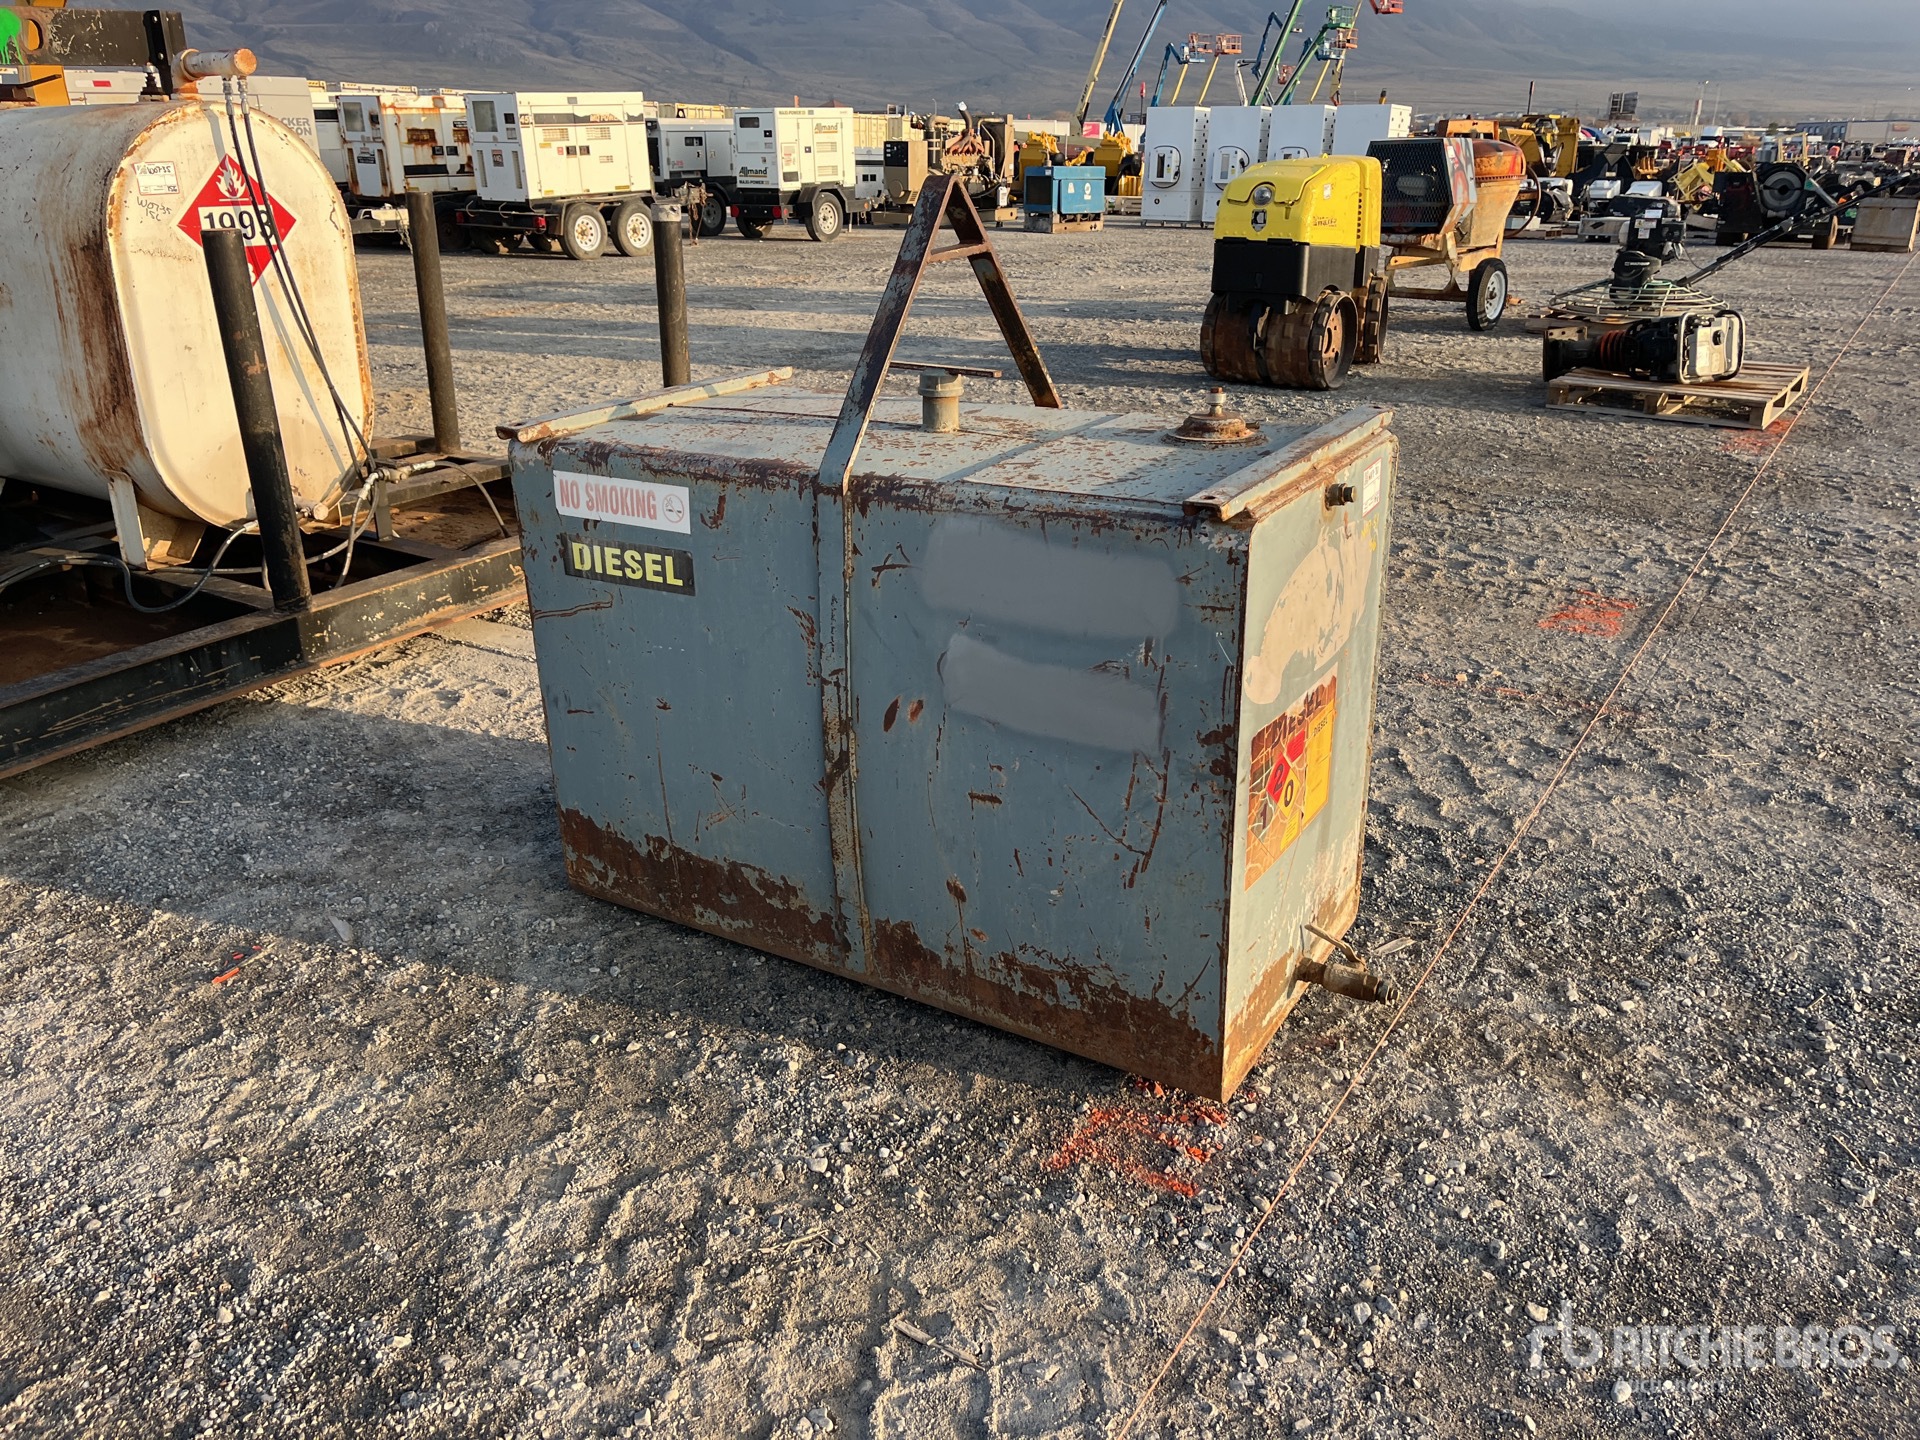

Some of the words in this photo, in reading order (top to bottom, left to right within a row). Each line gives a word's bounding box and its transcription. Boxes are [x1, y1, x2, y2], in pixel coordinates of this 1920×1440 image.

[814, 122, 838, 132] Allmand
[739, 166, 768, 177] Allmand
[559, 478, 581, 510] NO
[584, 481, 658, 521] SMOKING
[571, 541, 684, 587] DIESEL
[1273, 762, 1284, 794] 2
[1284, 778, 1294, 808] 0
[1259, 802, 1268, 831] 1
